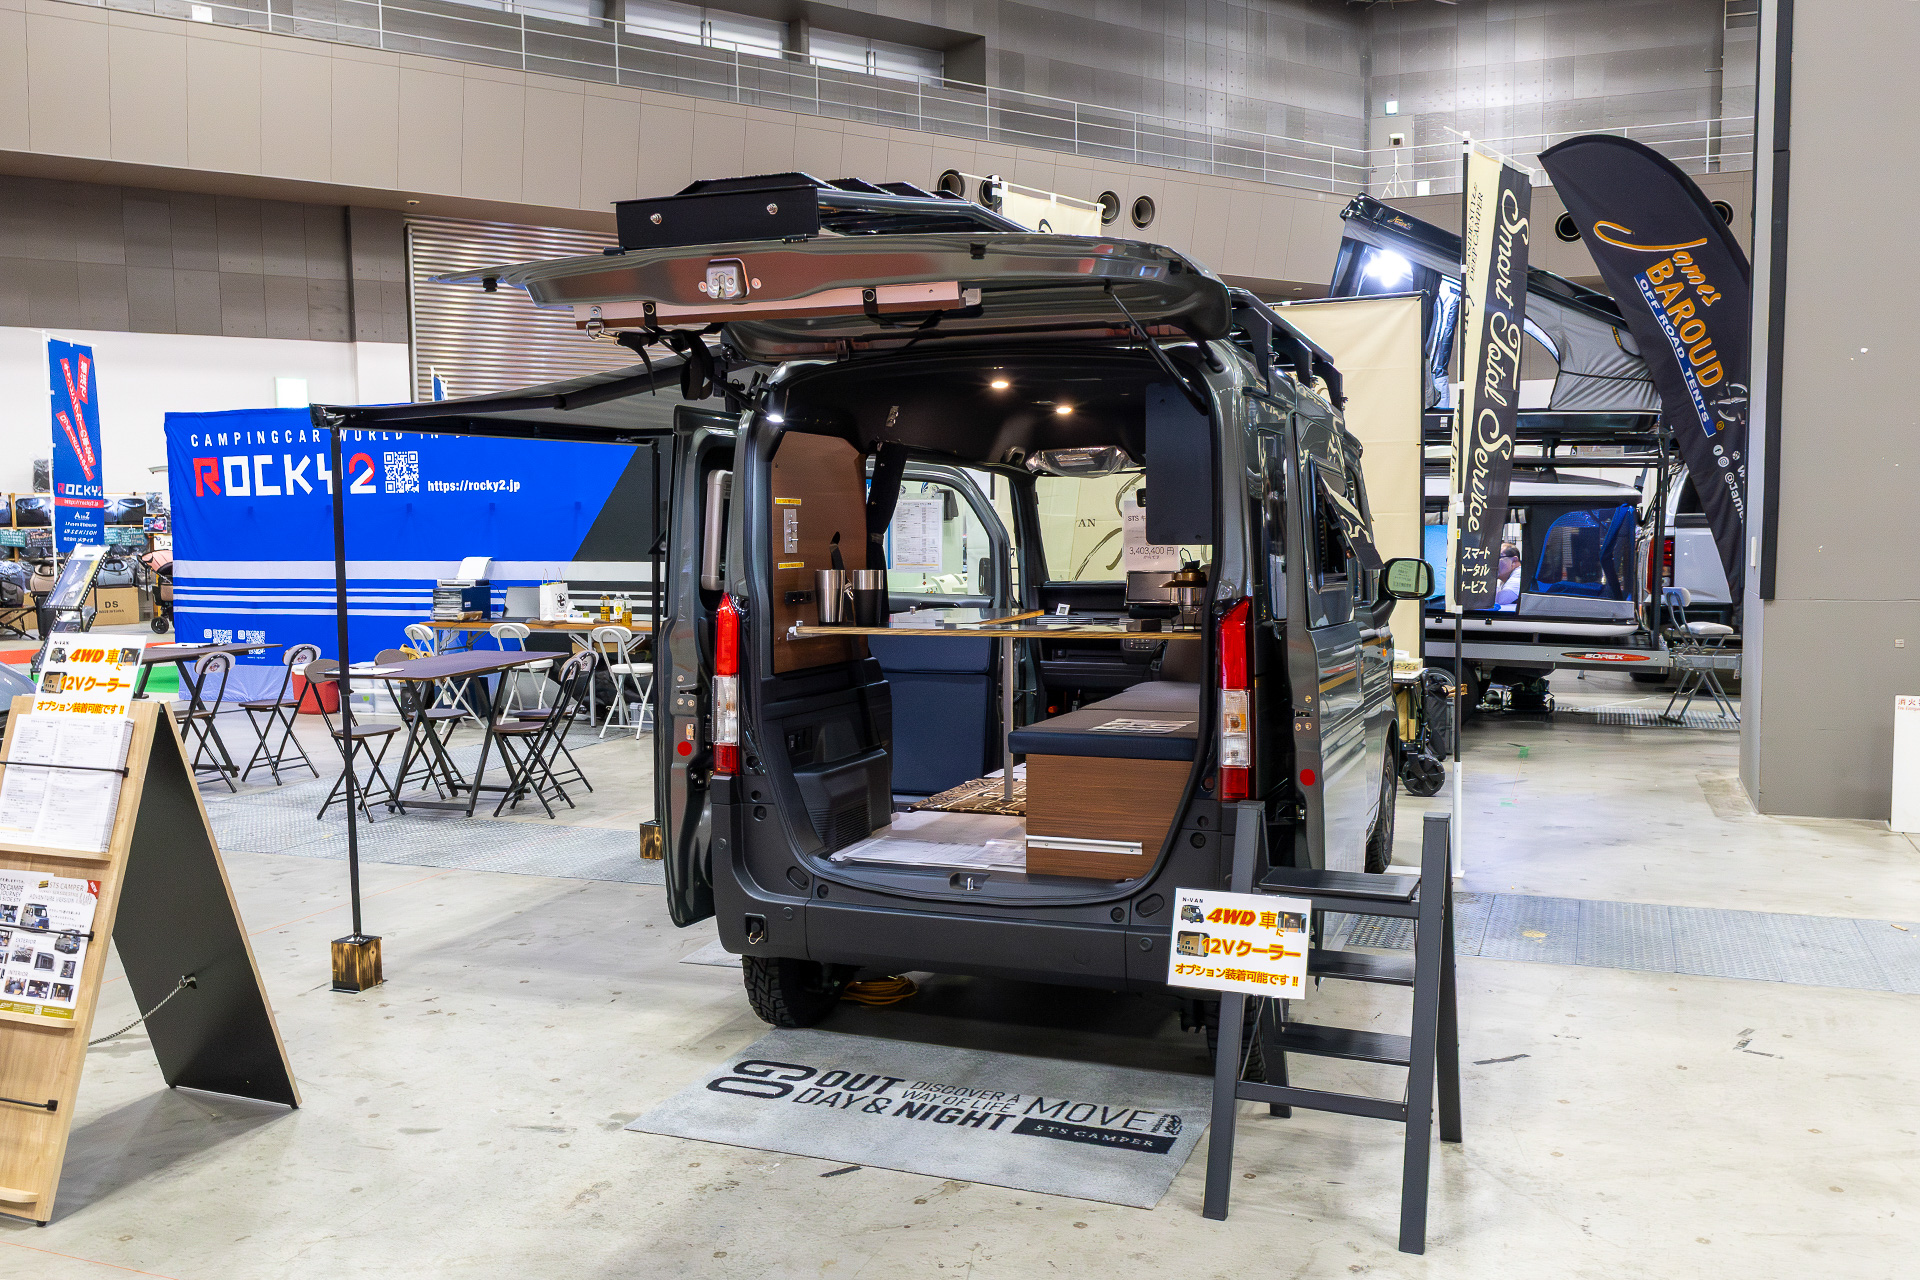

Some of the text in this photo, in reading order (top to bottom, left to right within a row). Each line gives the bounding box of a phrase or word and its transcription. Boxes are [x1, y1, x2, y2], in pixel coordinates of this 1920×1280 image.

[1473, 191, 1484, 246] CAMPER
[1469, 247, 1478, 282] DEEP
[1592, 220, 1722, 307] James
[1646, 257, 1724, 388] BAROUD
[1467, 188, 1529, 533] Smart Total Service
[1638, 278, 1710, 423] OFF ROAD TENTS
[190, 429, 321, 448] CAMPINGCAR
[427, 479, 521, 493] https://rocky2.jp
[1075, 518, 1096, 528] AN
[1166, 546, 1175, 556] 円
[1462, 546, 1491, 560] スマート
[104, 600, 119, 609] DS
[69, 648, 105, 664] 4WD
[104, 648, 121, 665] 車
[60, 674, 131, 693] 12Vクーラー
[1182, 896, 1204, 904] N-VAN
[1206, 907, 1285, 938] 4WD 車 に
[1201, 937, 1301, 961] 12Vクーラー
[813, 1070, 906, 1095] OUT
[910, 1081, 1021, 1103] DISCOVER A
[792, 1087, 870, 1109] DAY
[892, 1100, 1017, 1131] NIGHT
[901, 1089, 1016, 1112] WAY OF LIFE
[1022, 1096, 1155, 1131] MOVE
[1033, 1124, 1155, 1147] STS CAMPER
